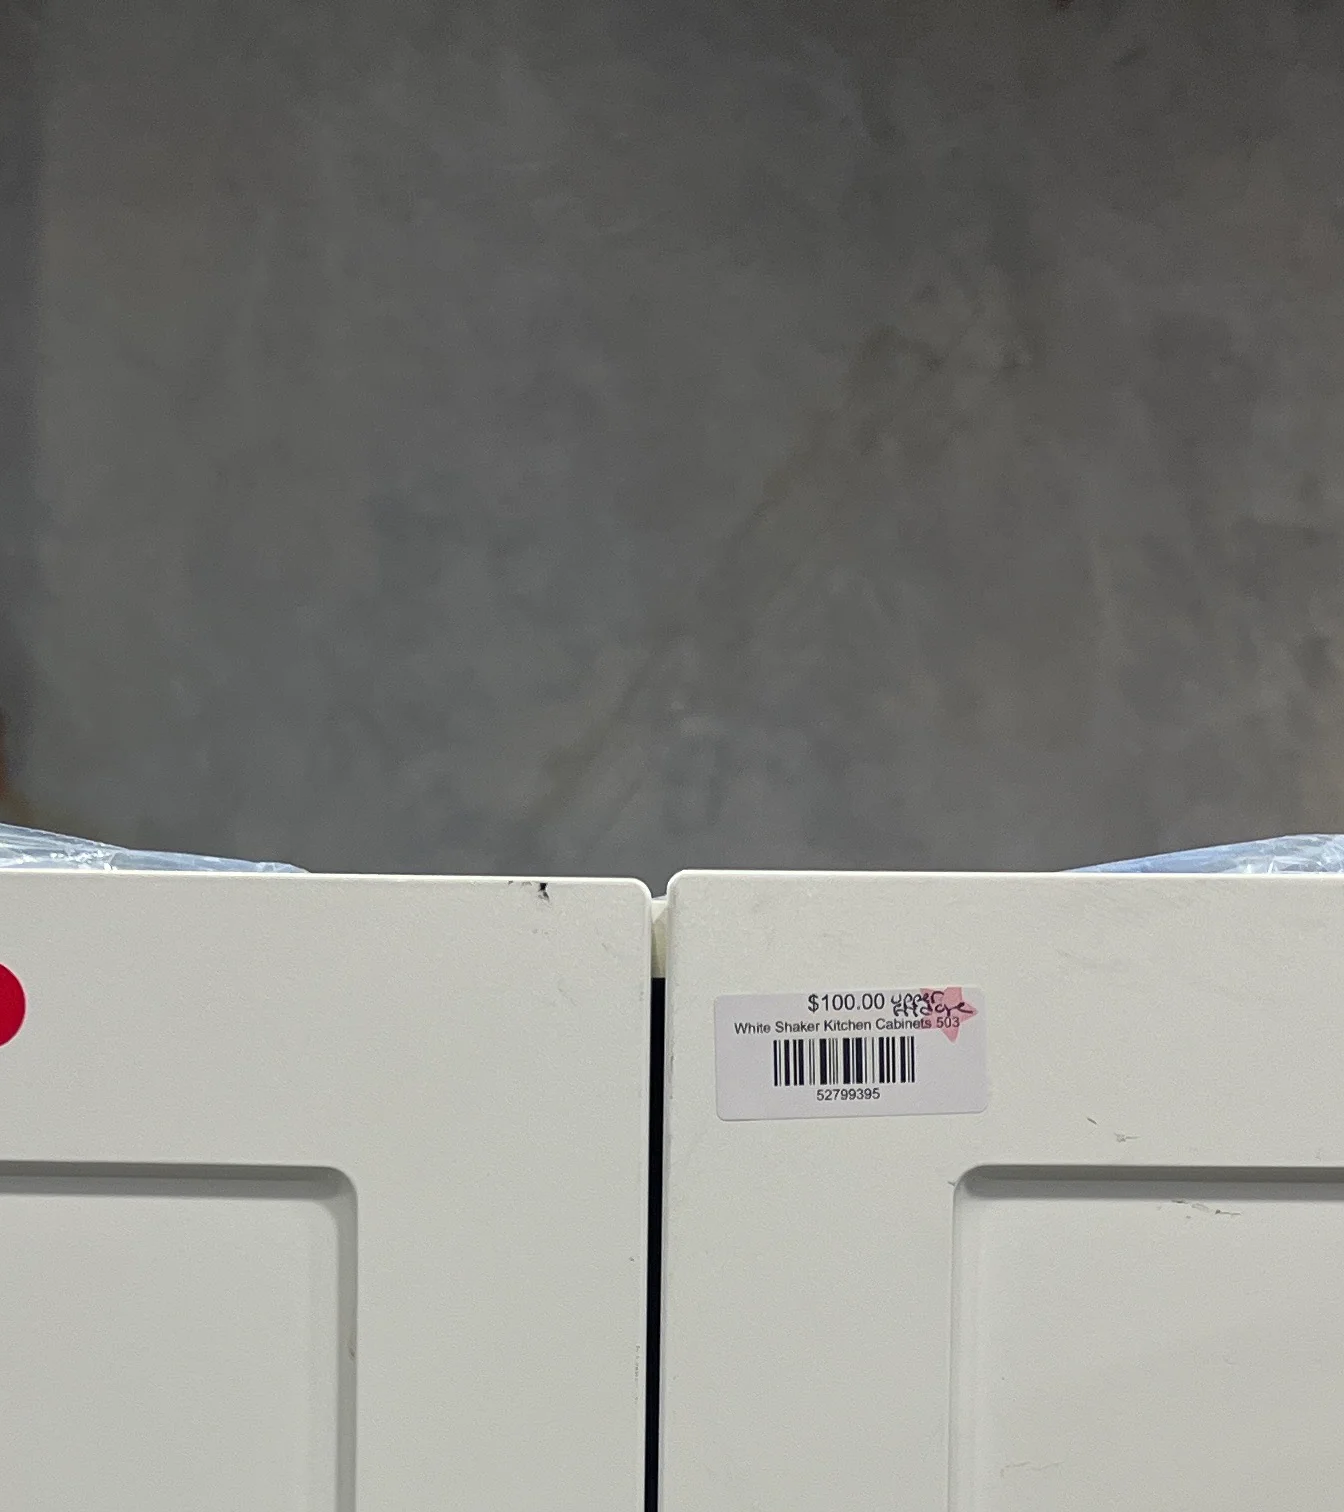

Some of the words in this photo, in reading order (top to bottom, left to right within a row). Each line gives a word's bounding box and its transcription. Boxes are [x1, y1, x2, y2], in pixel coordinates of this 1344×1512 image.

[808, 993, 886, 1013] $100.00
[734, 1022, 772, 1034] White
[775, 1020, 820, 1033] Shaker
[824, 1019, 872, 1032] Kitchen
[875, 1017, 933, 1031] Cabinets
[936, 1016, 961, 1029] 503
[816, 1088, 881, 1101] 52799395
